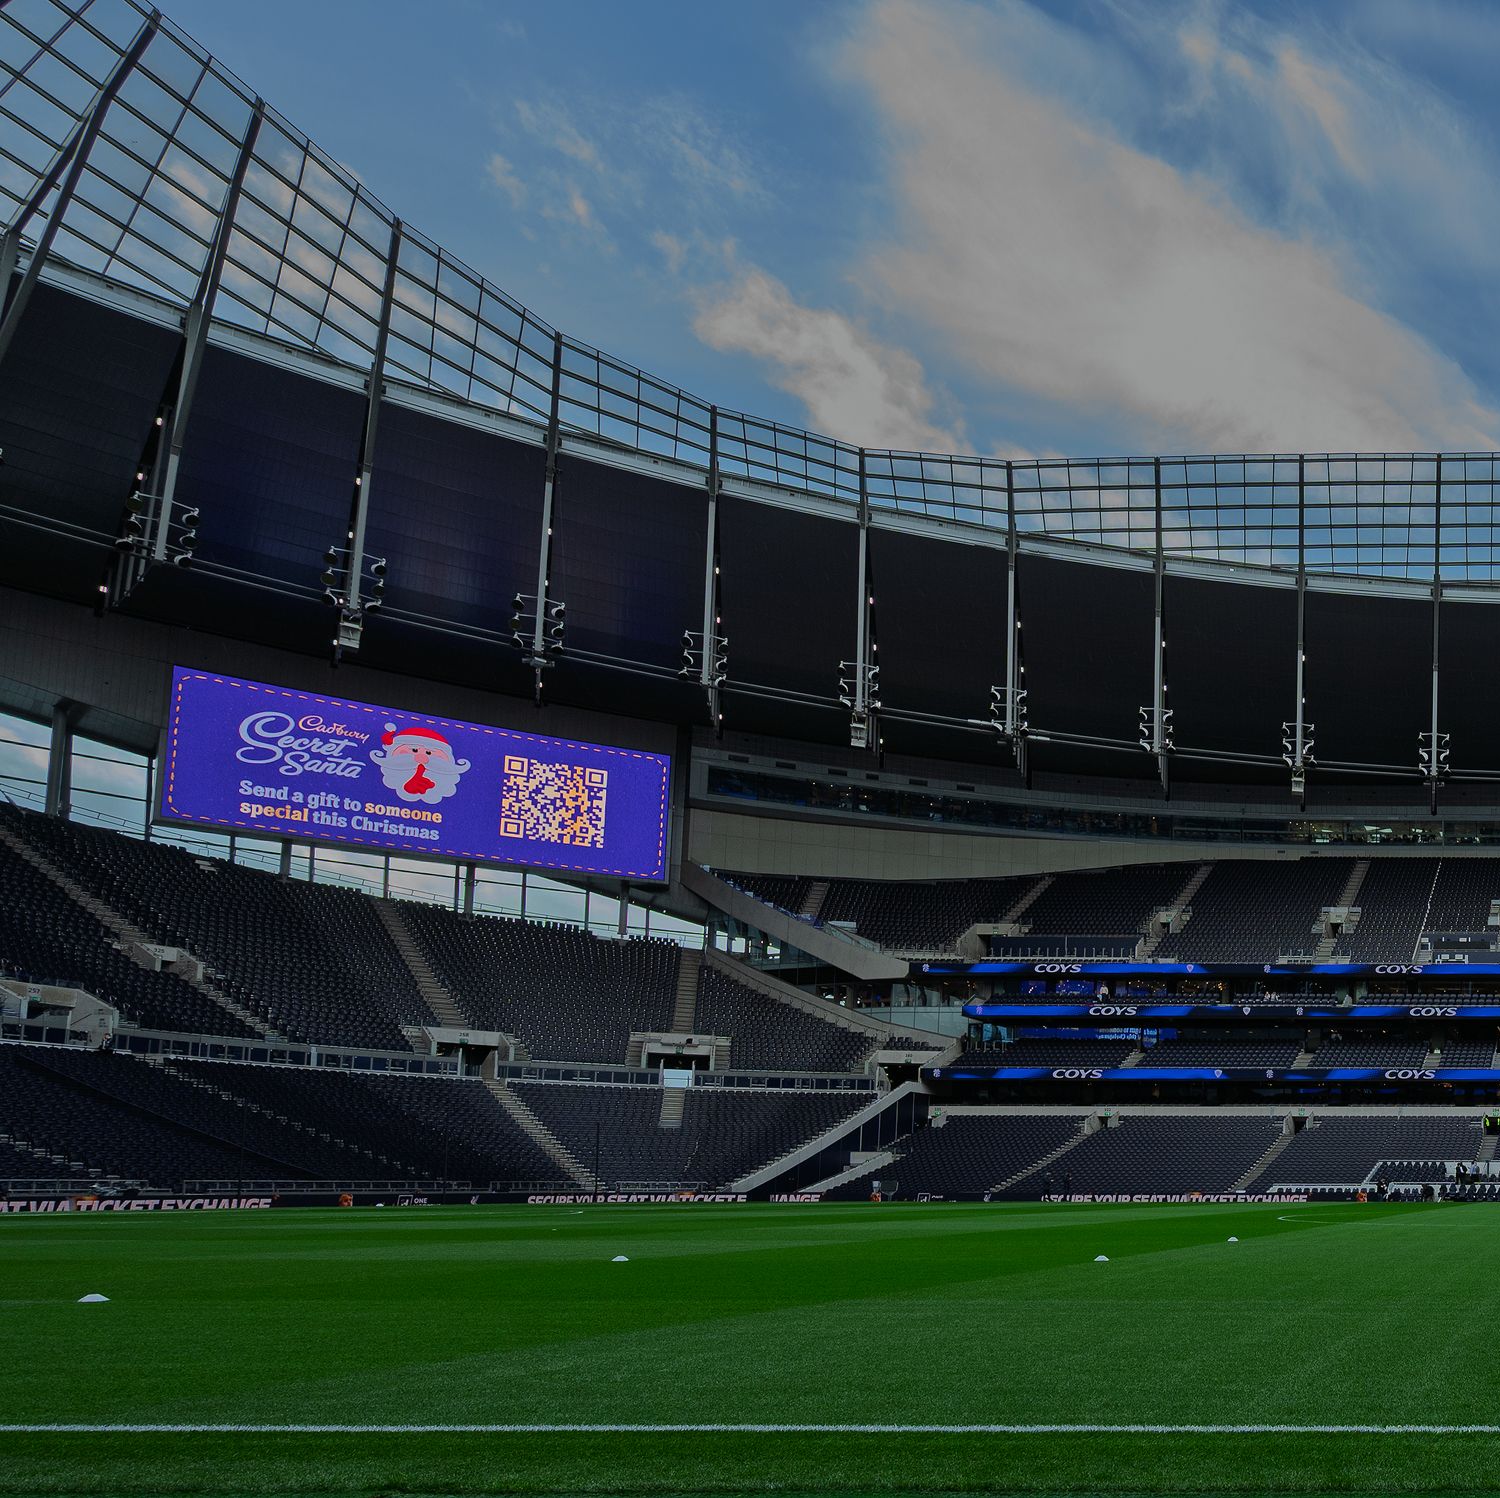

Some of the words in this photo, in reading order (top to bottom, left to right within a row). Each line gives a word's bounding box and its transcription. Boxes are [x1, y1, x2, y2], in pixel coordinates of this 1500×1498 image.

[299, 715, 370, 744] Cadbury
[236, 711, 358, 764] Secret
[279, 751, 366, 779] Santa
[238, 780, 288, 801] Send
[291, 791, 304, 803] a
[307, 790, 340, 810] gift
[343, 798, 361, 811] to
[364, 802, 443, 824] someone
[239, 802, 309, 823] special
[312, 811, 348, 828] this
[351, 815, 440, 841] Christmas
[1034, 963, 1082, 973] COYS
[1375, 964, 1424, 974] COYS
[1089, 1005, 1138, 1016] COYS
[1409, 1006, 1457, 1017] COYS
[1052, 1068, 1103, 1079] COYS
[1384, 1069, 1435, 1080] COYS
[77, 1199, 160, 1212] TICKET
